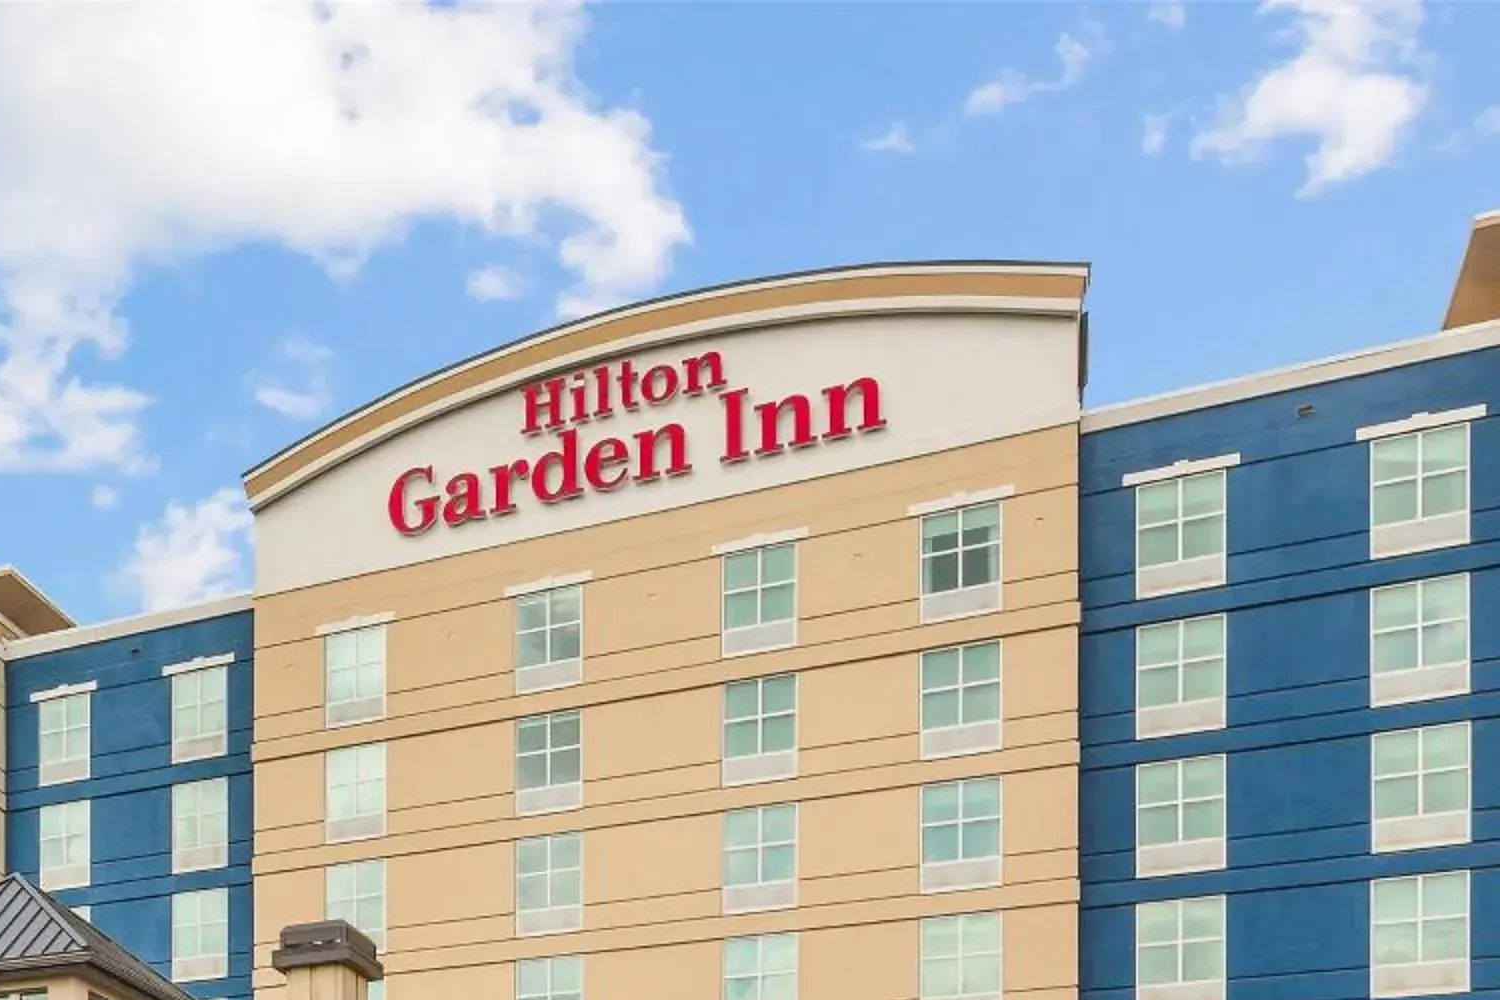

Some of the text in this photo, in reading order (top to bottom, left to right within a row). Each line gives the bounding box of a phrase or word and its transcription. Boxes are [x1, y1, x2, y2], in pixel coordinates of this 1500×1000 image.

[521, 351, 728, 436] Hilton
[388, 375, 887, 536] Garden Inn
